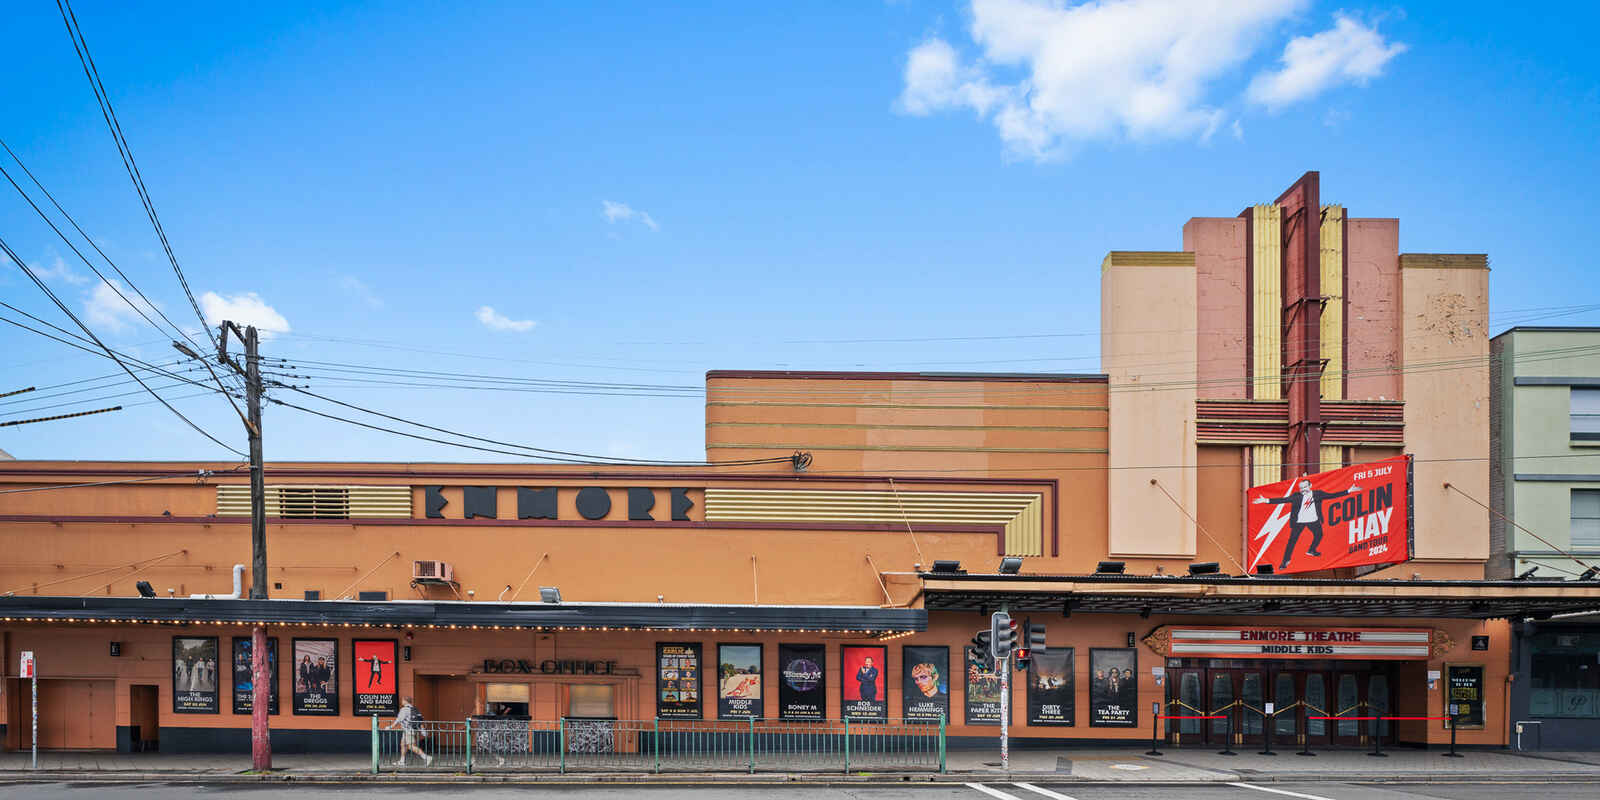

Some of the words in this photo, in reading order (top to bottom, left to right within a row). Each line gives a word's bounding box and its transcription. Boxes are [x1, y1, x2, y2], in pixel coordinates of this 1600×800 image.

[1353, 471, 1366, 481] FRI
[1367, 470, 1374, 479] 5
[1375, 465, 1393, 477] JULY
[425, 485, 694, 521] ENMORE
[1328, 483, 1393, 526] COLIN
[1348, 507, 1394, 544] HAY
[1368, 544, 1388, 557] 2024
[1240, 630, 1297, 641] ENMORE
[1304, 631, 1362, 642] THEATRE
[1261, 645, 1303, 654] MIDDLE
[1307, 645, 1334, 654] KIDS
[484, 659, 531, 674] BOX
[541, 659, 617, 675] OFFICE
